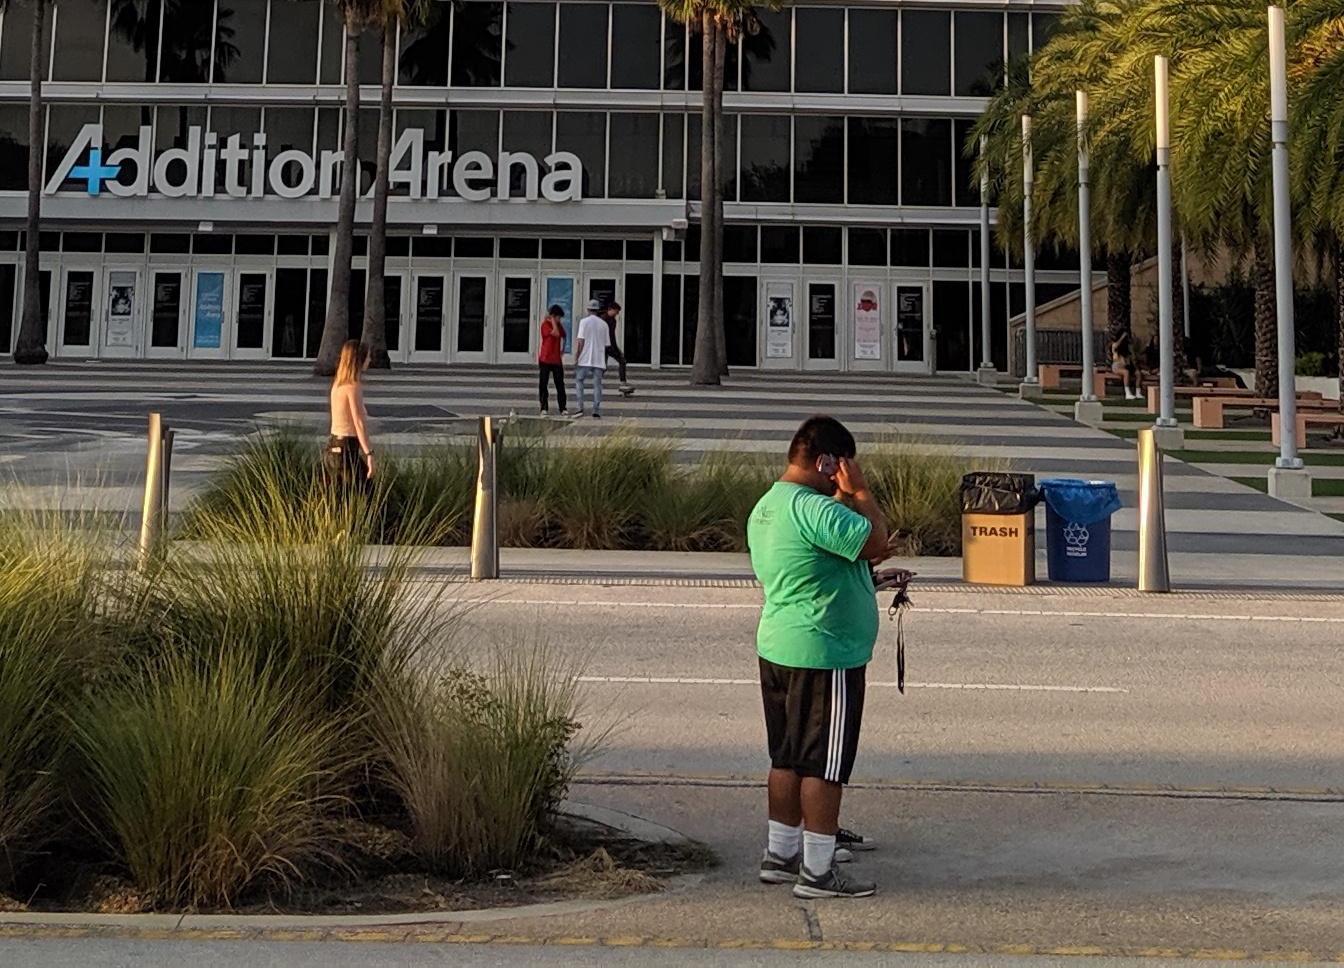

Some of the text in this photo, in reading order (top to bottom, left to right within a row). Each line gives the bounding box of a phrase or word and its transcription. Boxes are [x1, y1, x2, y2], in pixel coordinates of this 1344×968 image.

[44, 123, 583, 202] Addition Arena
[970, 526, 1019, 538] TRASH
